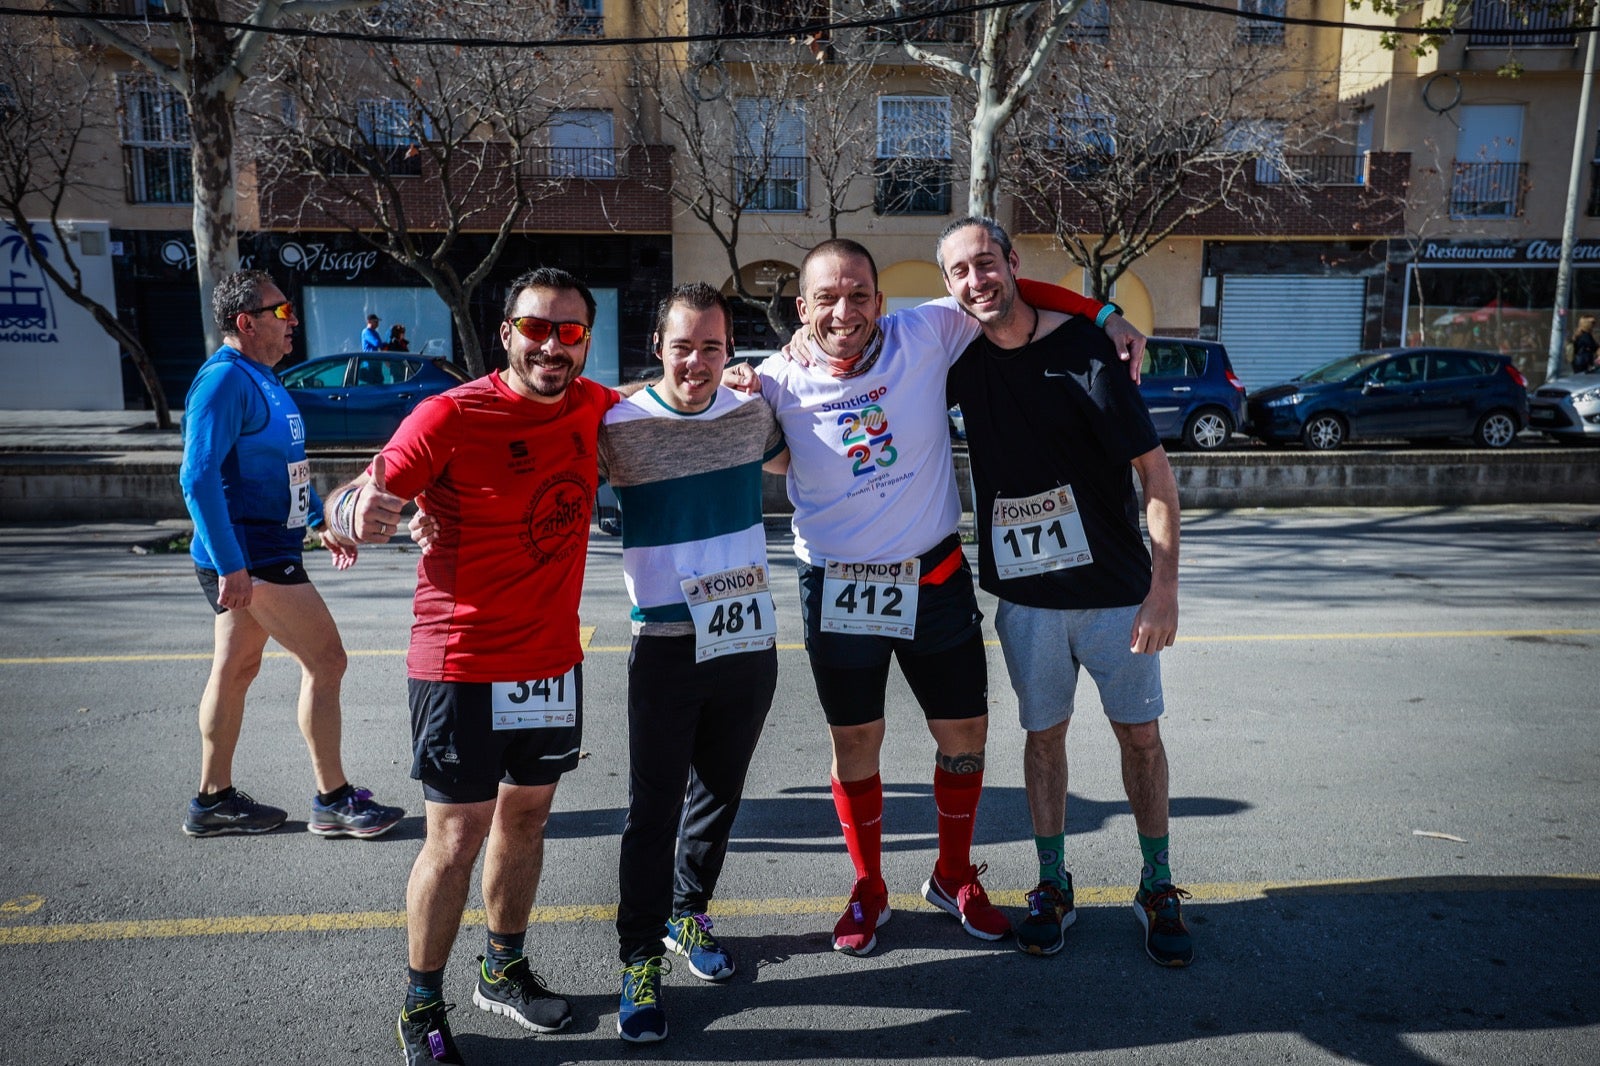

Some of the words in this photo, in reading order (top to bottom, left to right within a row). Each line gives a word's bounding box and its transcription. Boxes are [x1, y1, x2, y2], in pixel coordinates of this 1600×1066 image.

[280, 242, 377, 280] Visage
[1425, 243, 1516, 259] Restaurante
[822, 386, 887, 411] Santiago
[867, 472, 890, 485] Juegos
[1003, 500, 1055, 519] FONDO
[1003, 520, 1067, 558] 171
[705, 573, 754, 594] FONDO
[835, 584, 903, 617] 412
[708, 598, 762, 637] 481
[508, 674, 564, 704] 341
